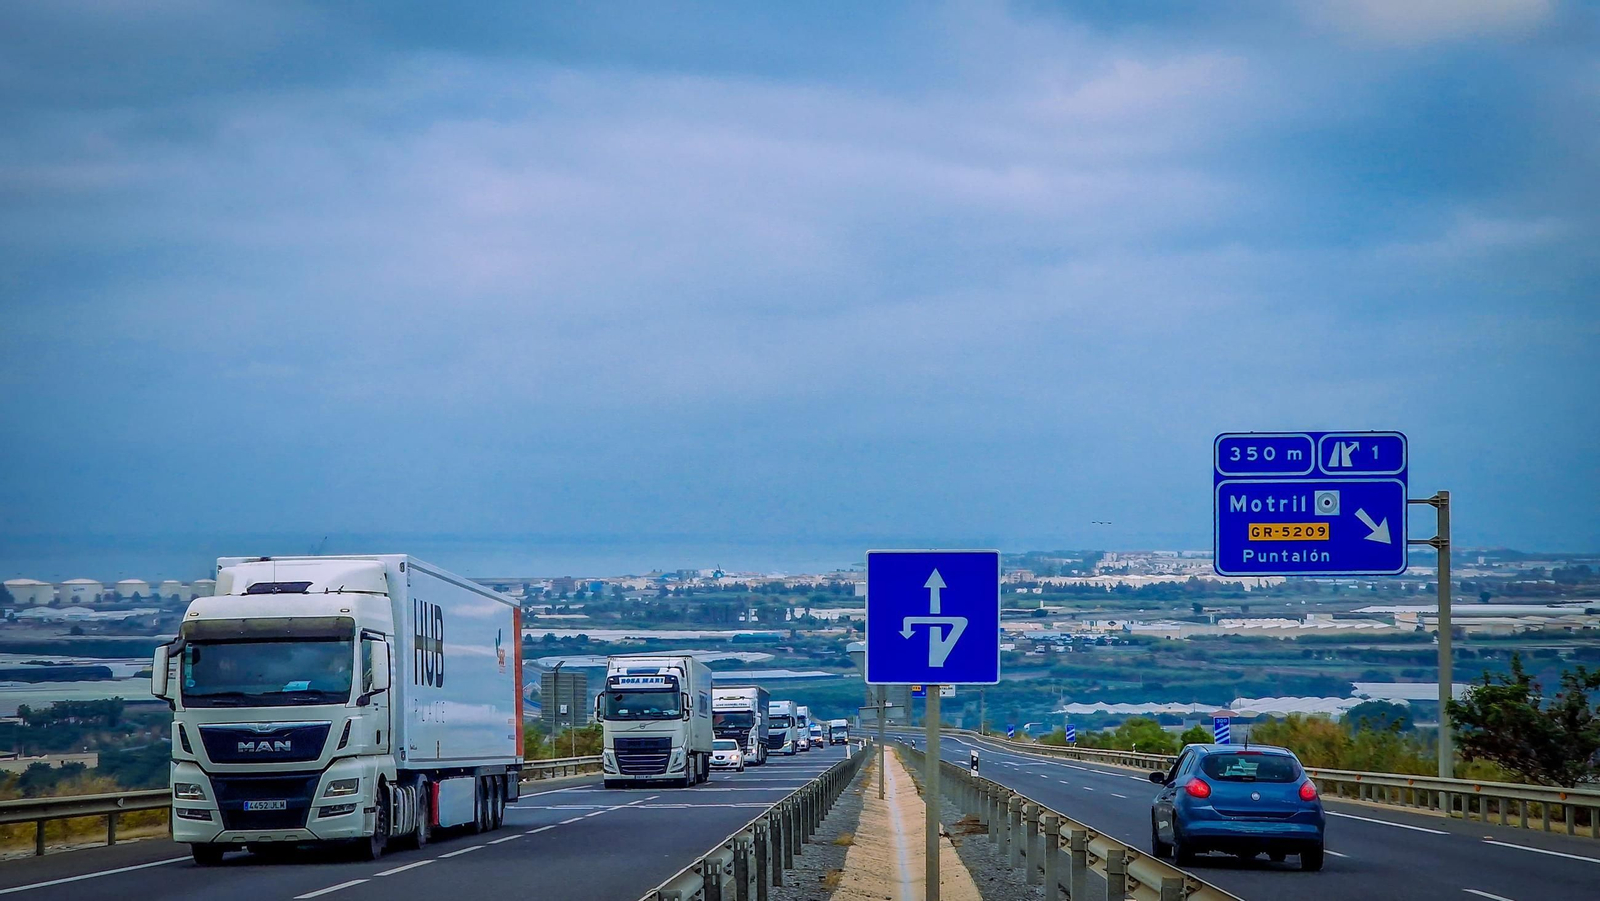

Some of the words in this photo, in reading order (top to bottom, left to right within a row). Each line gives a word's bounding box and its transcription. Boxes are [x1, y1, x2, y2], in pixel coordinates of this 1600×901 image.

[1229, 446, 1276, 462] 350
[1287, 449, 1303, 461] m
[1371, 445, 1379, 460] 1
[1229, 494, 1306, 513] Motril
[1251, 526, 1326, 538] GR-5209
[1242, 549, 1330, 563] Puntalón
[413, 598, 444, 689] HUB
[237, 740, 292, 753] MAN
[249, 801, 269, 810] 4452
